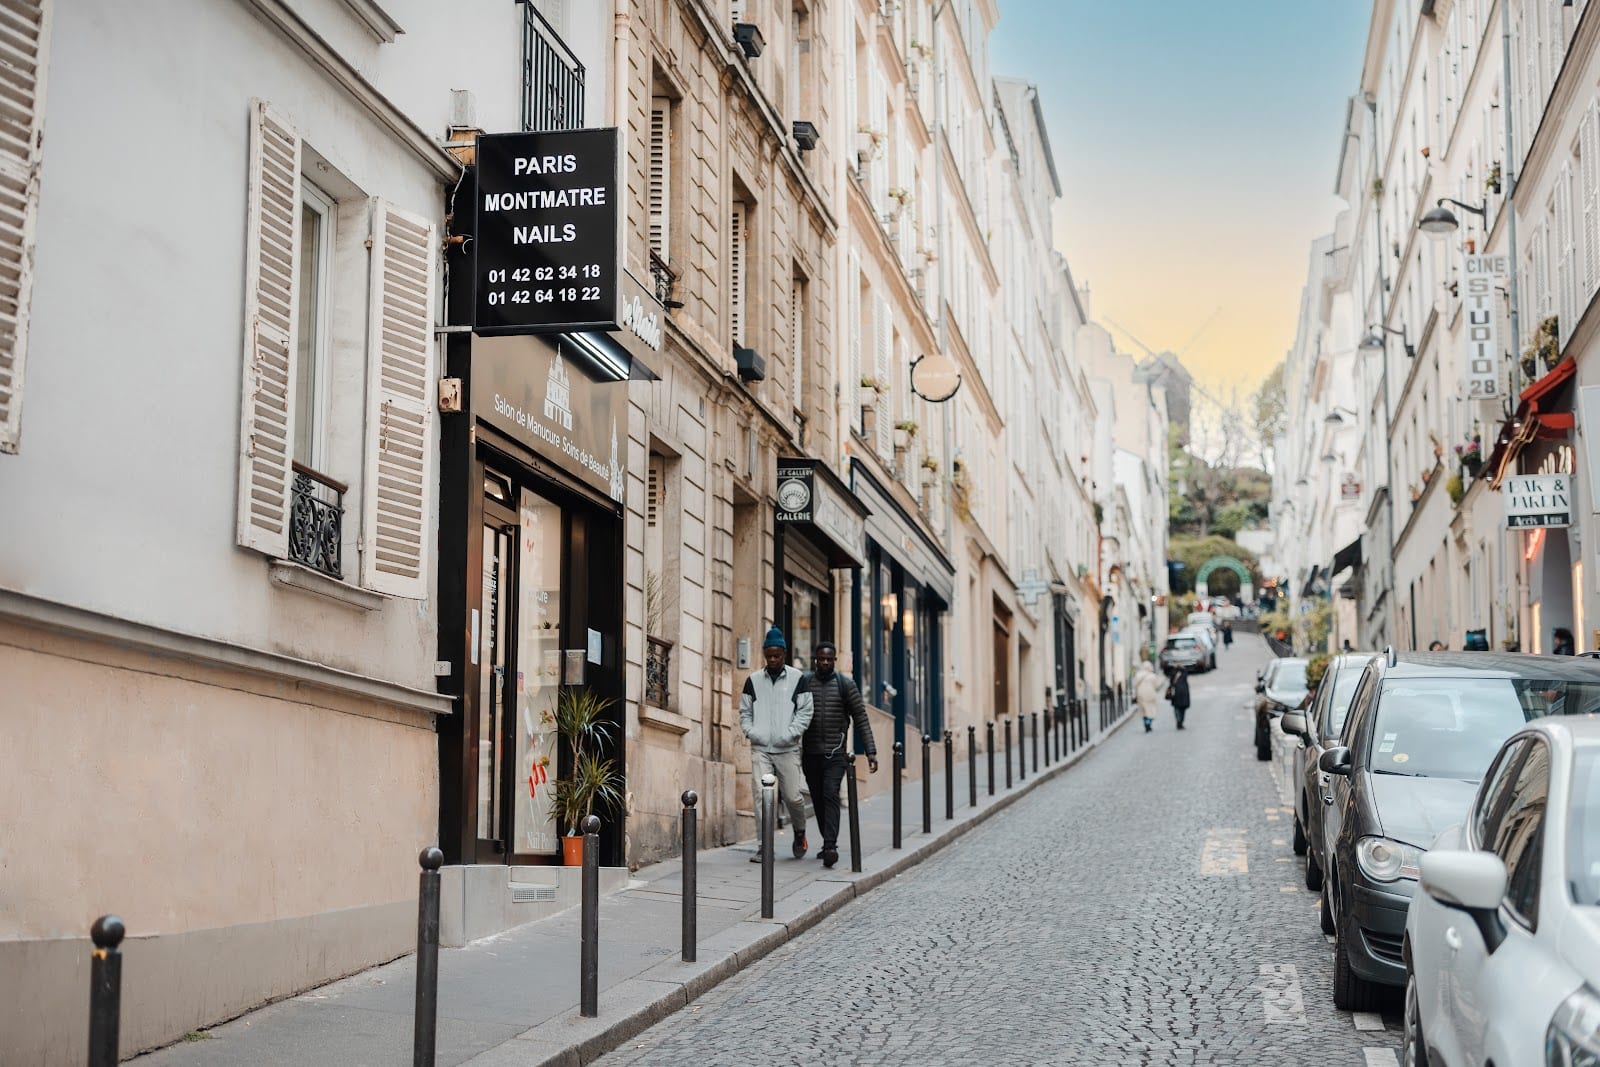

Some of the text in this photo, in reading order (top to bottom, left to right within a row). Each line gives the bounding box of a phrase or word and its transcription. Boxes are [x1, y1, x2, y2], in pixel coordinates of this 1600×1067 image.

[514, 154, 577, 175] PARIS
[484, 187, 606, 211] MONTMATRE
[513, 224, 576, 244] NAILS
[488, 264, 601, 283] 01 42 62 34 18
[488, 286, 601, 305] 01 42 64 18 22
[1468, 277, 1492, 374] STUDIO
[1470, 380, 1496, 395] 28
[494, 393, 609, 481] Salon de Manucure Soins de Beauté
[1553, 479, 1564, 491] &
[776, 512, 811, 521] GALERIE
